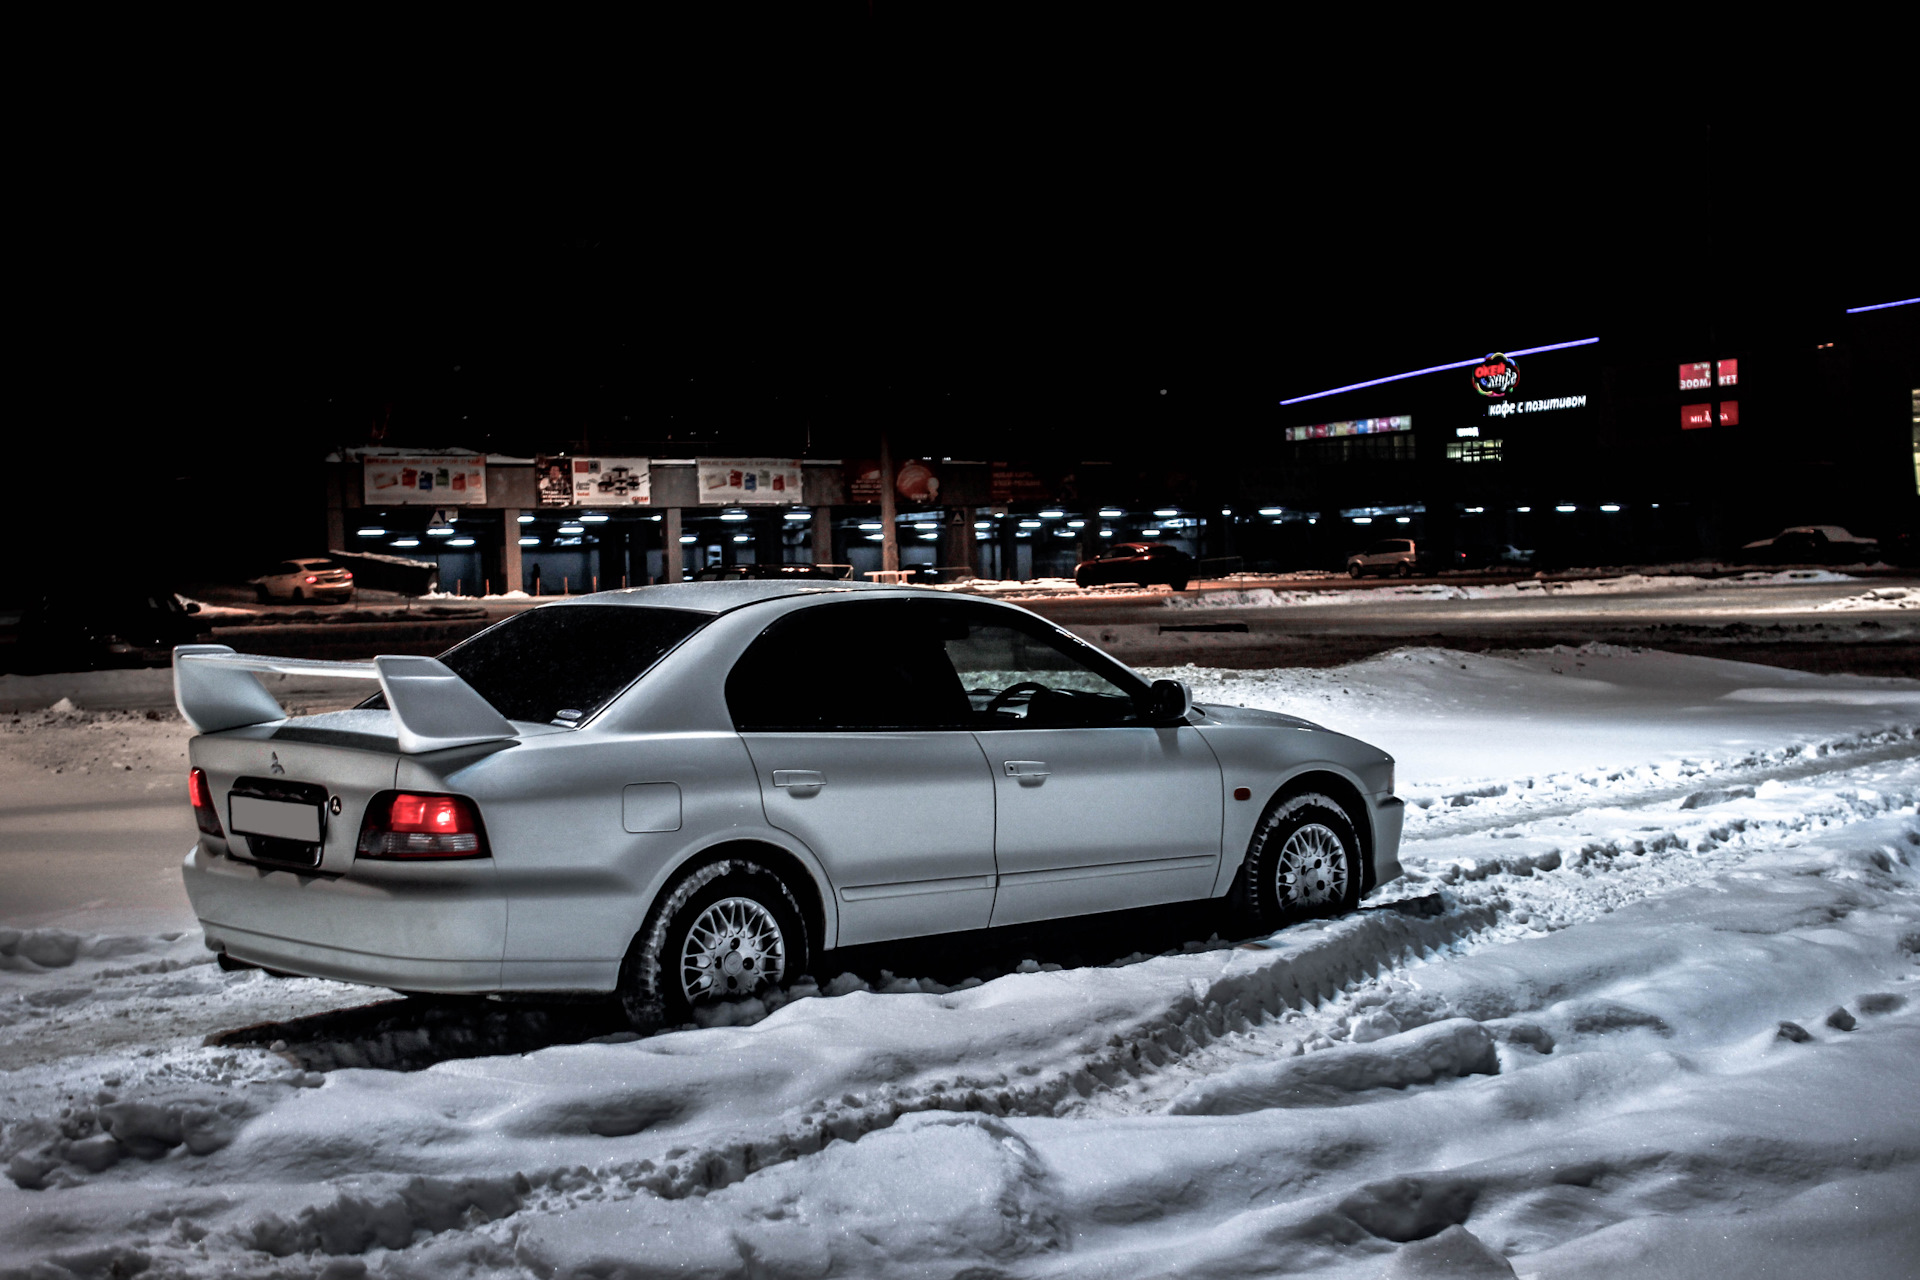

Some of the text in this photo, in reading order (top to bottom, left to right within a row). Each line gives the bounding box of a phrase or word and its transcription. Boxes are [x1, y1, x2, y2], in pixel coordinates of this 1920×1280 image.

[1488, 395, 1587, 418] кафе с позитивом
